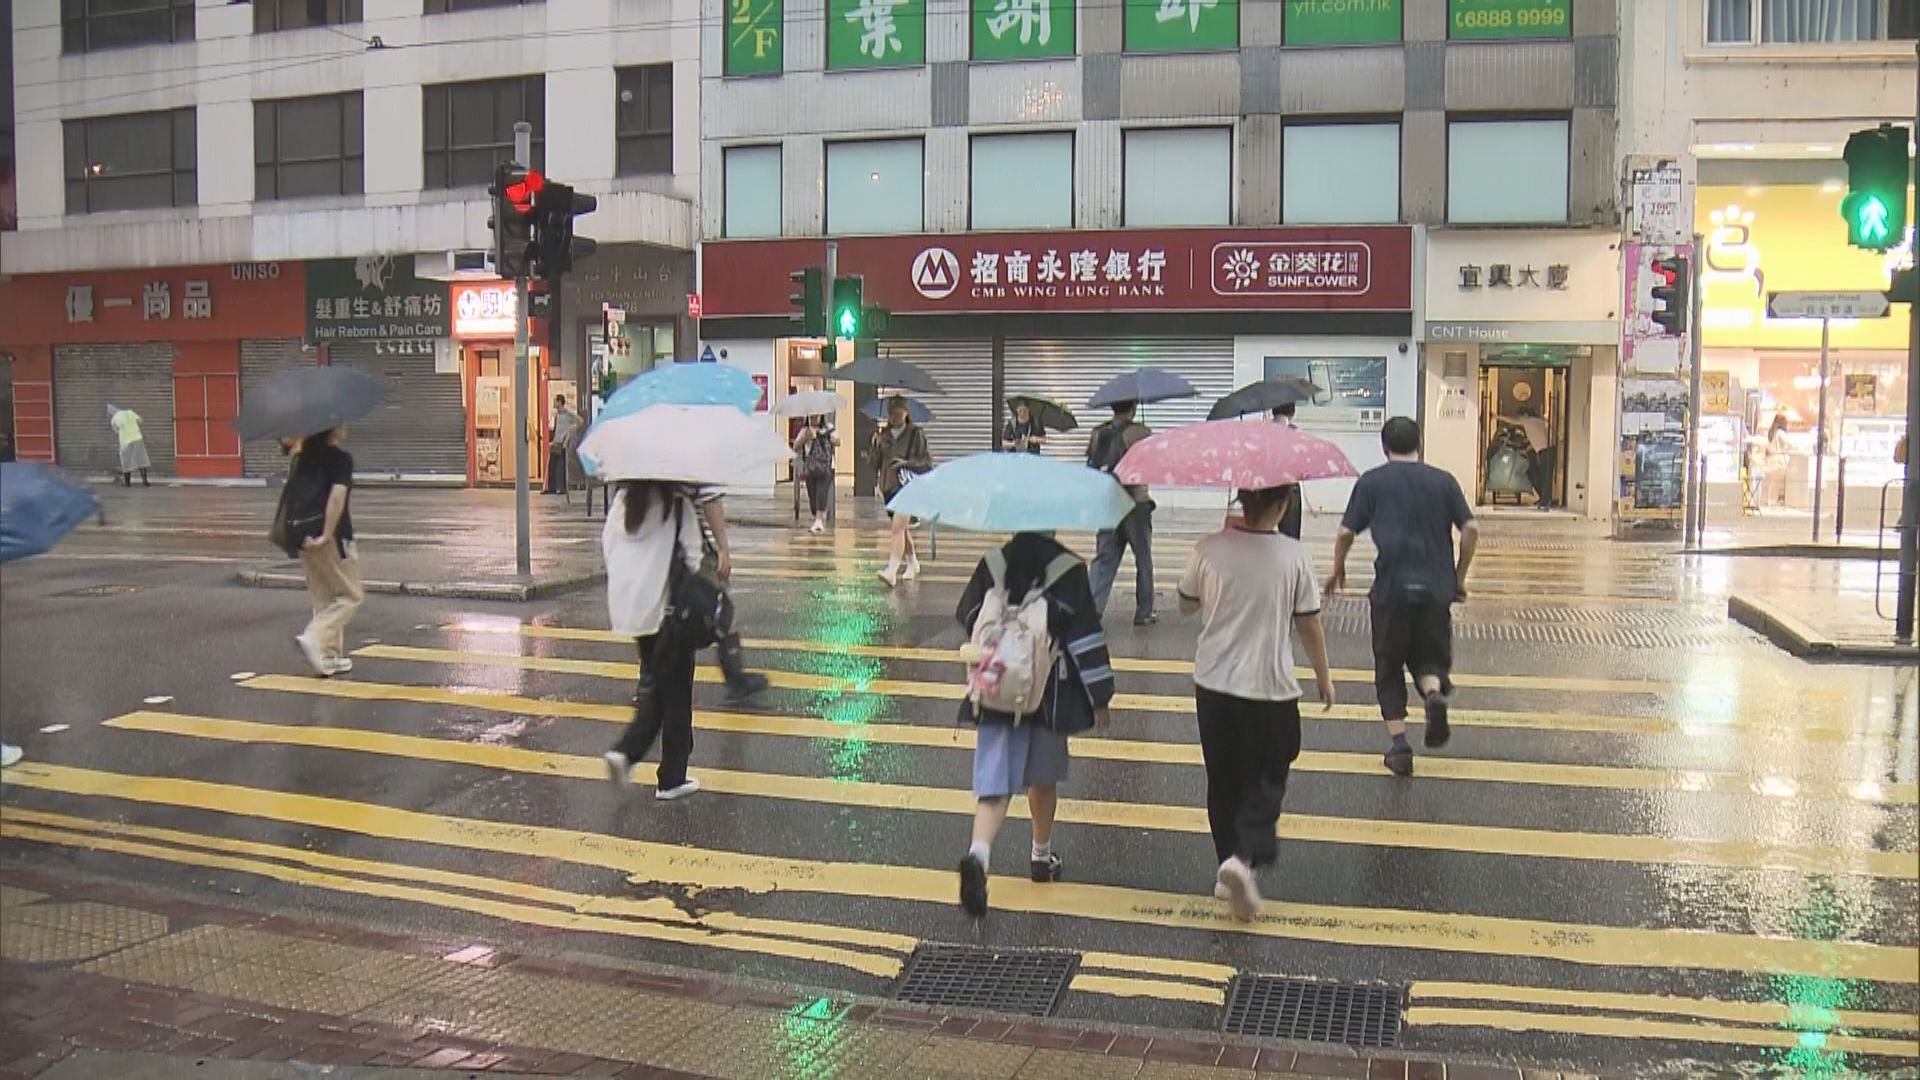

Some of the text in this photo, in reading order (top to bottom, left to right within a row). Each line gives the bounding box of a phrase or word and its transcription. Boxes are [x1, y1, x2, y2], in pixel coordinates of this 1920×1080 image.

[1464, 8, 1565, 27] 6888 9999
[970, 249, 1167, 284] 招商永隆銀行
[1268, 252, 1346, 273] 金葵花
[231, 263, 280, 280] UNISO
[1268, 274, 1358, 288] SUNFLOWER
[971, 285, 1165, 298] CMB WING LUNG BANK
[315, 323, 442, 338] Hair Reborn & Pain Care
[1431, 326, 1509, 338] CNT House
